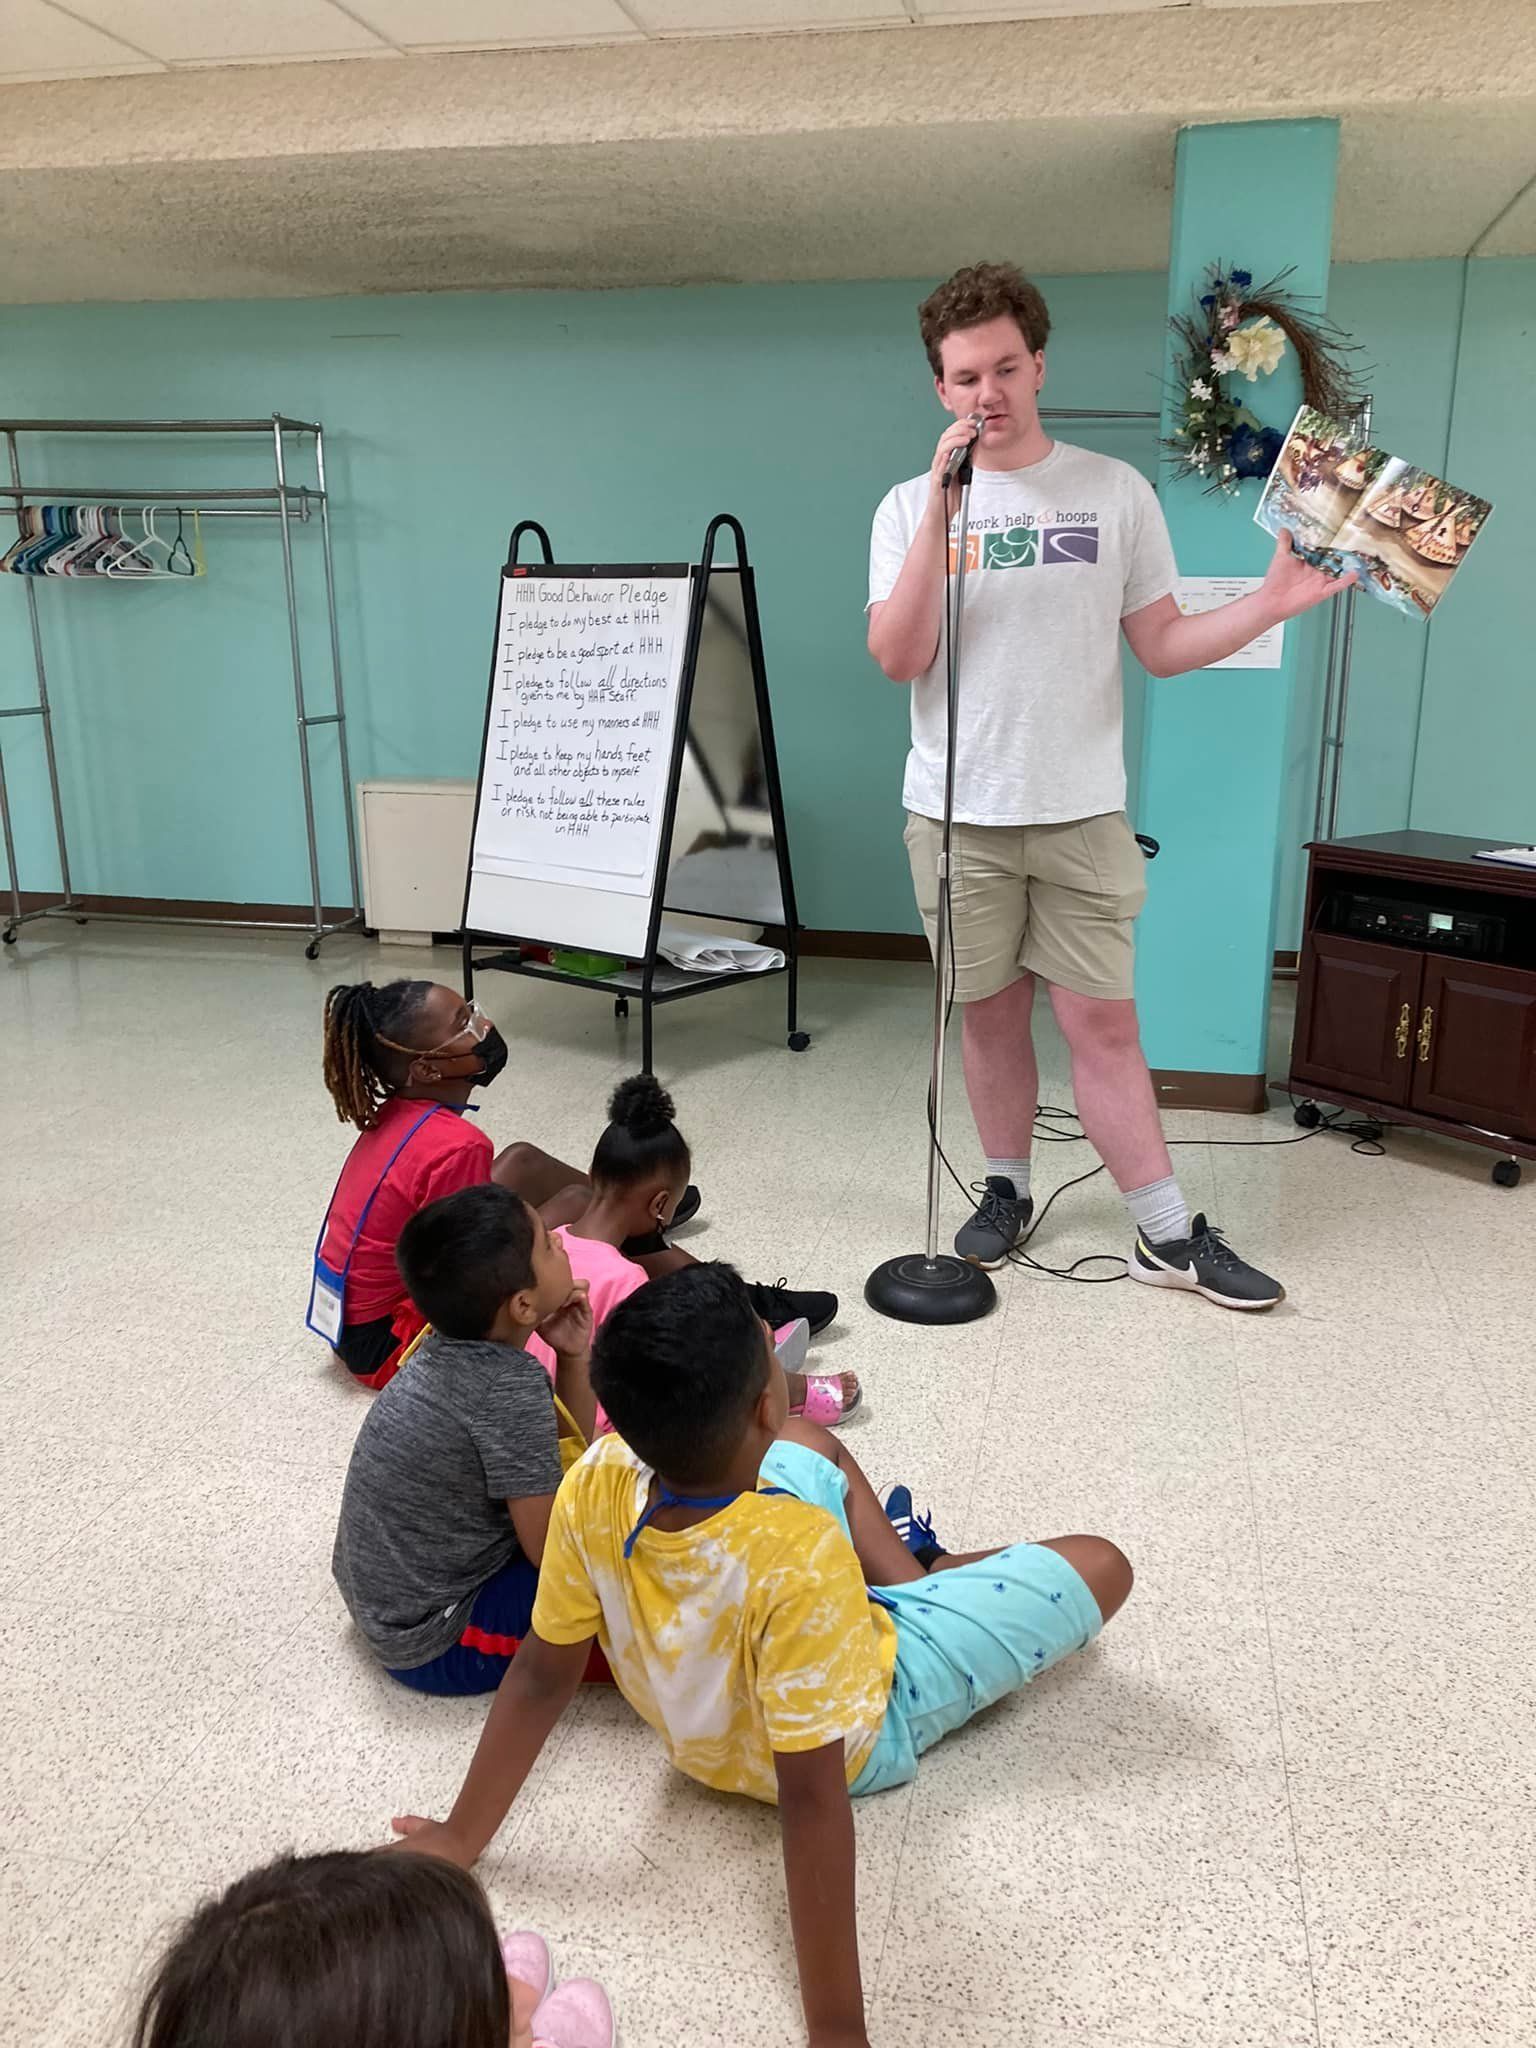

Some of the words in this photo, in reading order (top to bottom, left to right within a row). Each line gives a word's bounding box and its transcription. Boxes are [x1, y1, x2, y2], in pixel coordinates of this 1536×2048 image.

[1005, 513, 1034, 528] help
[1037, 507, 1053, 524] &
[1056, 510, 1097, 524] hoops
[516, 583, 536, 602] HHH
[538, 582, 564, 602] Good
[567, 581, 614, 603] Behavior
[620, 581, 668, 608] Pledge
[507, 612, 517, 631] I
[519, 610, 548, 637] pledge
[550, 616, 559, 628] to
[561, 611, 571, 628] do
[574, 615, 587, 634] my
[588, 610, 612, 626] best
[616, 612, 628, 624] at
[504, 643, 514, 663] I
[518, 646, 544, 665] pledge
[547, 645, 555, 659] to
[557, 638, 568, 659] be
[576, 642, 596, 664] good
[597, 640, 619, 661] sport
[622, 641, 634, 655] at
[502, 670, 513, 690] I
[515, 673, 543, 695] pledge
[546, 678, 554, 688] to
[560, 668, 592, 690] follow
[598, 664, 617, 691] all
[620, 665, 667, 689] directions
[544, 690, 553, 701] to
[556, 691, 569, 700] me
[574, 690, 585, 710] by
[588, 689, 605, 702] HHH
[497, 709, 512, 728] I
[513, 711, 542, 736] pledge
[546, 713, 557, 728] to
[560, 718, 578, 729] use
[582, 719, 595, 737] my
[598, 718, 629, 729] manners
[631, 716, 639, 727] at
[496, 739, 509, 760] I
[510, 744, 539, 765] pledge
[543, 746, 552, 760] to
[555, 743, 573, 766] keep
[577, 751, 591, 769] my
[514, 765, 531, 776] and
[534, 762, 545, 776] all
[548, 763, 571, 776] other
[572, 761, 600, 782] objects
[602, 765, 609, 777] to
[491, 783, 503, 801] I
[506, 787, 533, 809] pledge
[537, 791, 545, 804] to
[548, 785, 577, 805] follow
[578, 789, 594, 807] all
[597, 790, 620, 806] these
[623, 792, 646, 806] rules
[501, 807, 512, 817] or
[516, 806, 537, 818] risk
[540, 808, 554, 820] not
[556, 807, 578, 825] being
[580, 809, 599, 821] able
[601, 810, 609, 822] to
